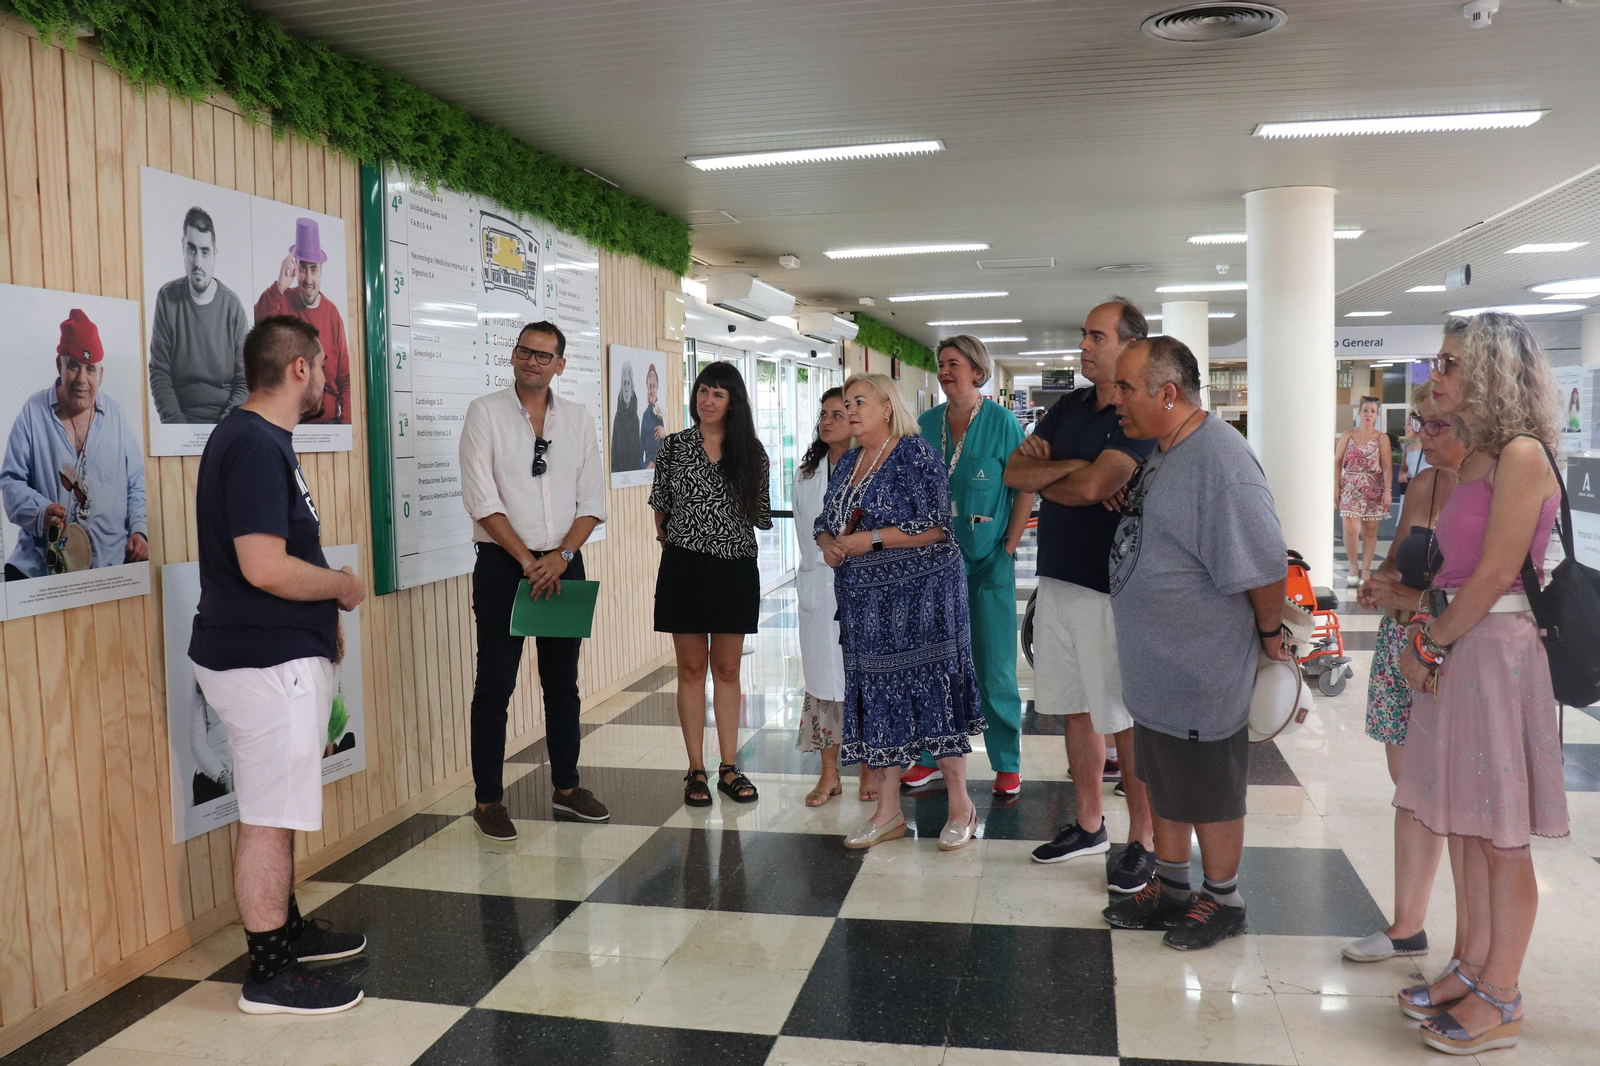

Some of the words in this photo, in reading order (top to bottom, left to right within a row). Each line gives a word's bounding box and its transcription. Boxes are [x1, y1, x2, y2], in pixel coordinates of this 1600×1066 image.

[392, 195, 402, 212] 4ª
[394, 277, 404, 294] 3ª
[485, 332, 489, 344] 1
[493, 334, 514, 348] Entrada
[1342, 338, 1383, 347] General
[396, 352, 406, 369] 2ª
[485, 354, 490, 365] 2
[494, 355, 512, 367] Cafete
[486, 374, 490, 386] 3
[494, 375, 516, 387] Consul
[399, 418, 408, 436] 1ª
[404, 501, 409, 518] 0
